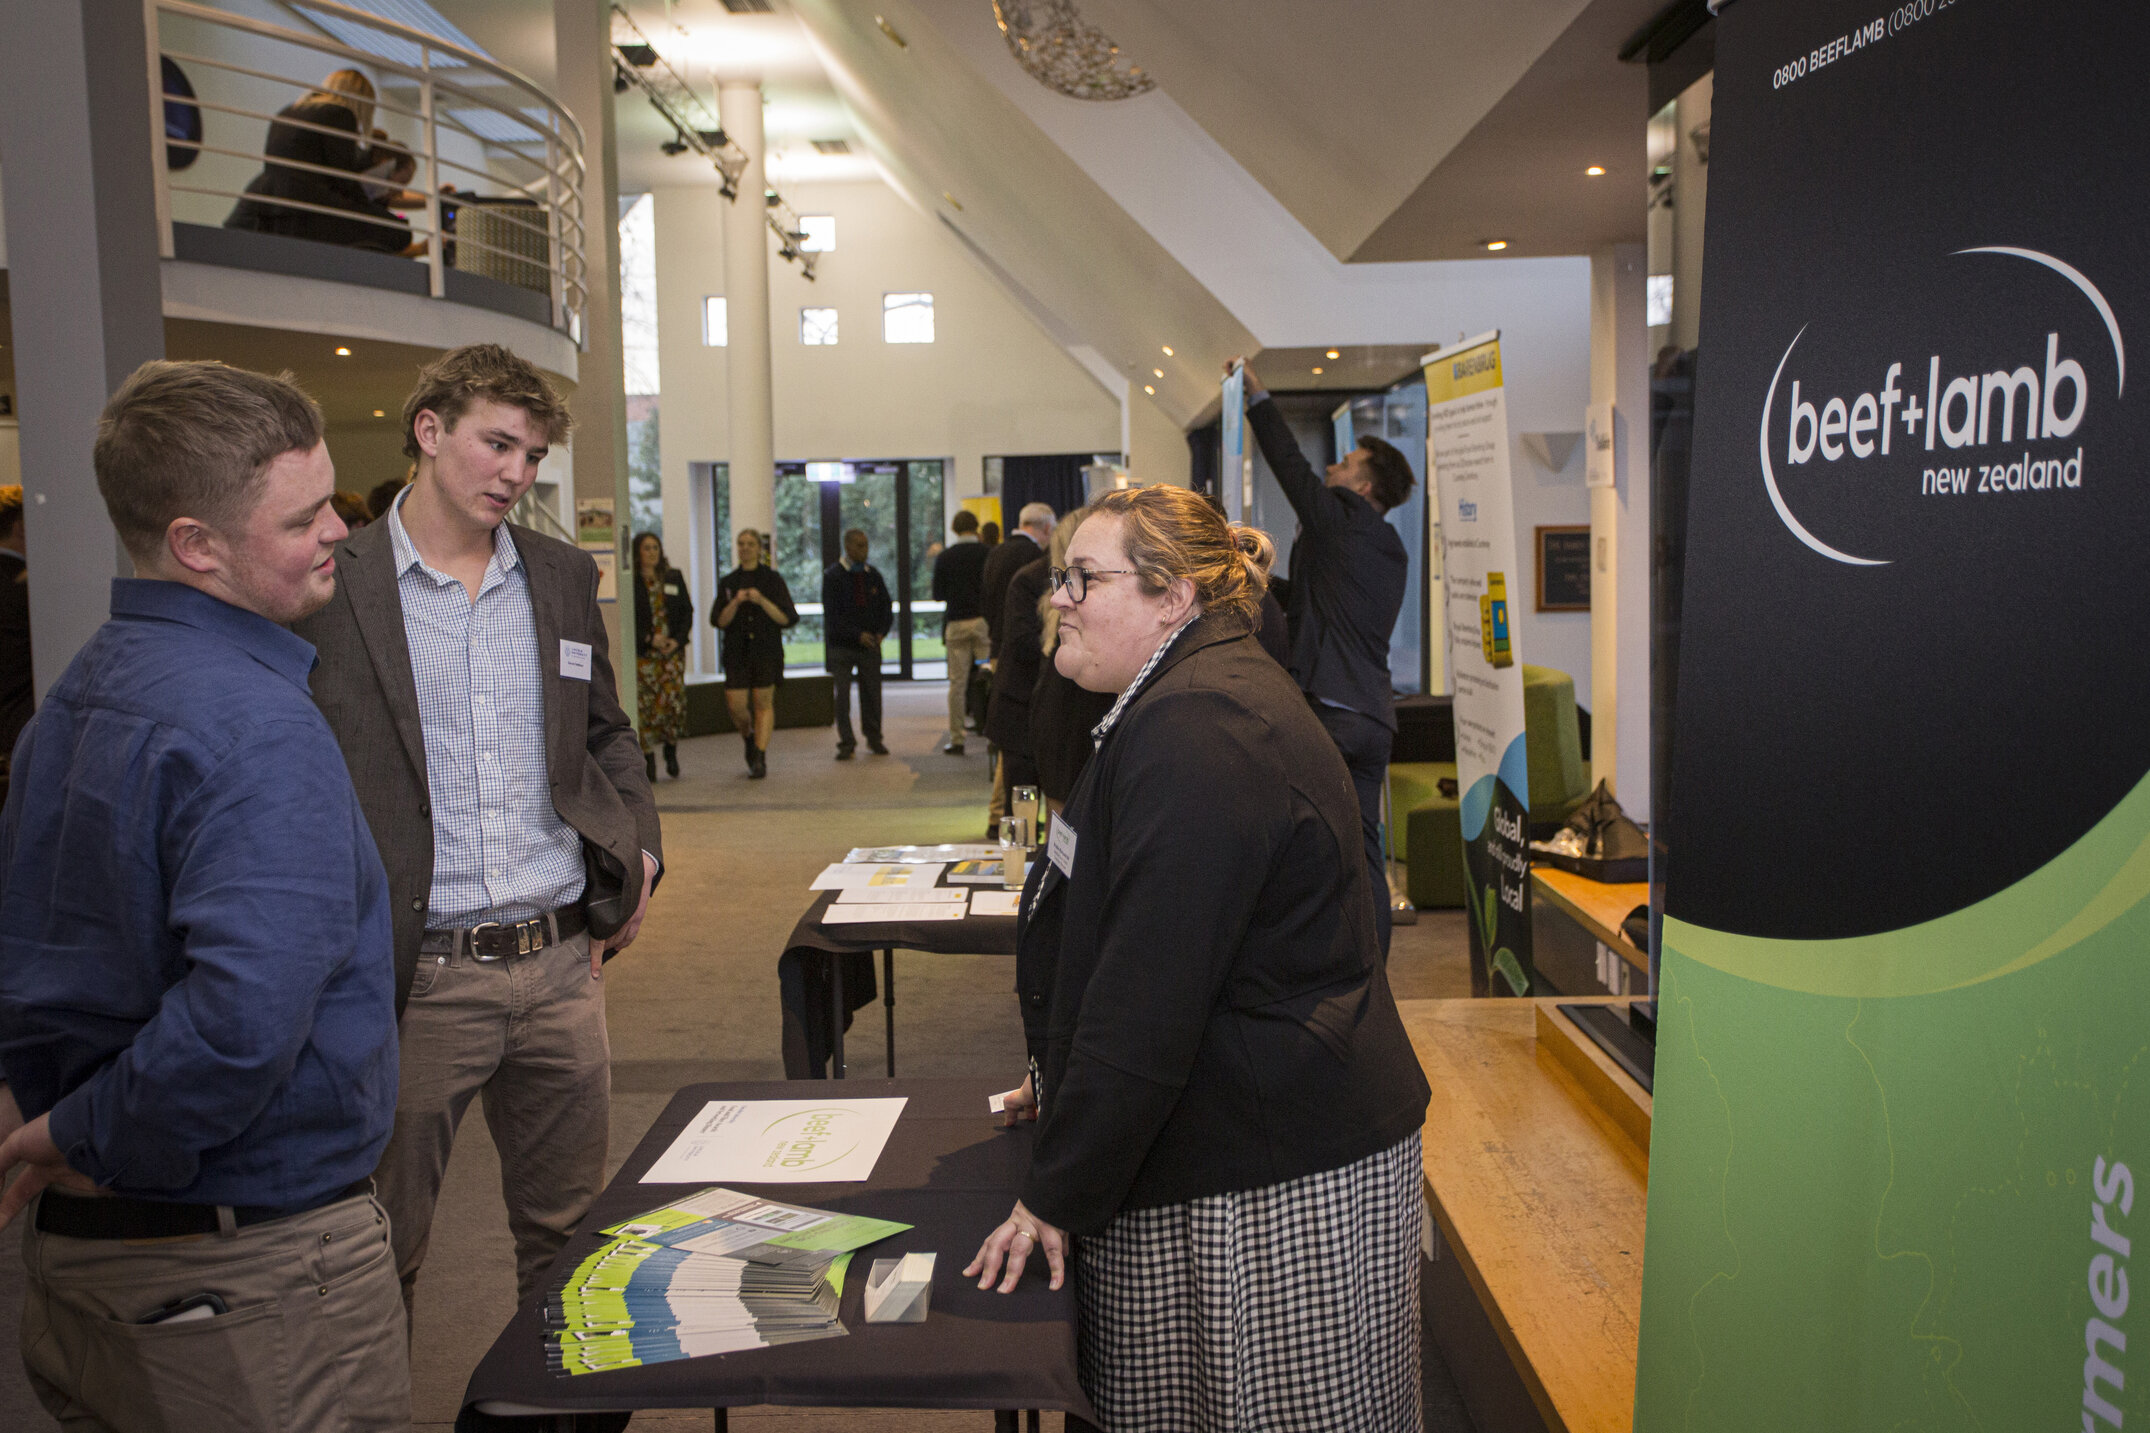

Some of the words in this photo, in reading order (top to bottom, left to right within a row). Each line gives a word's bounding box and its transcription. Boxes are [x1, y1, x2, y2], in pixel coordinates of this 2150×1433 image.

[1773, 56, 1807, 90] 0800
[1809, 17, 1885, 73] BEEFLAMB
[1787, 332, 2088, 465] beef+lamb
[1922, 467, 1971, 495] new
[1977, 447, 2083, 493] zealand
[780, 1113, 843, 1168] beef+lamb
